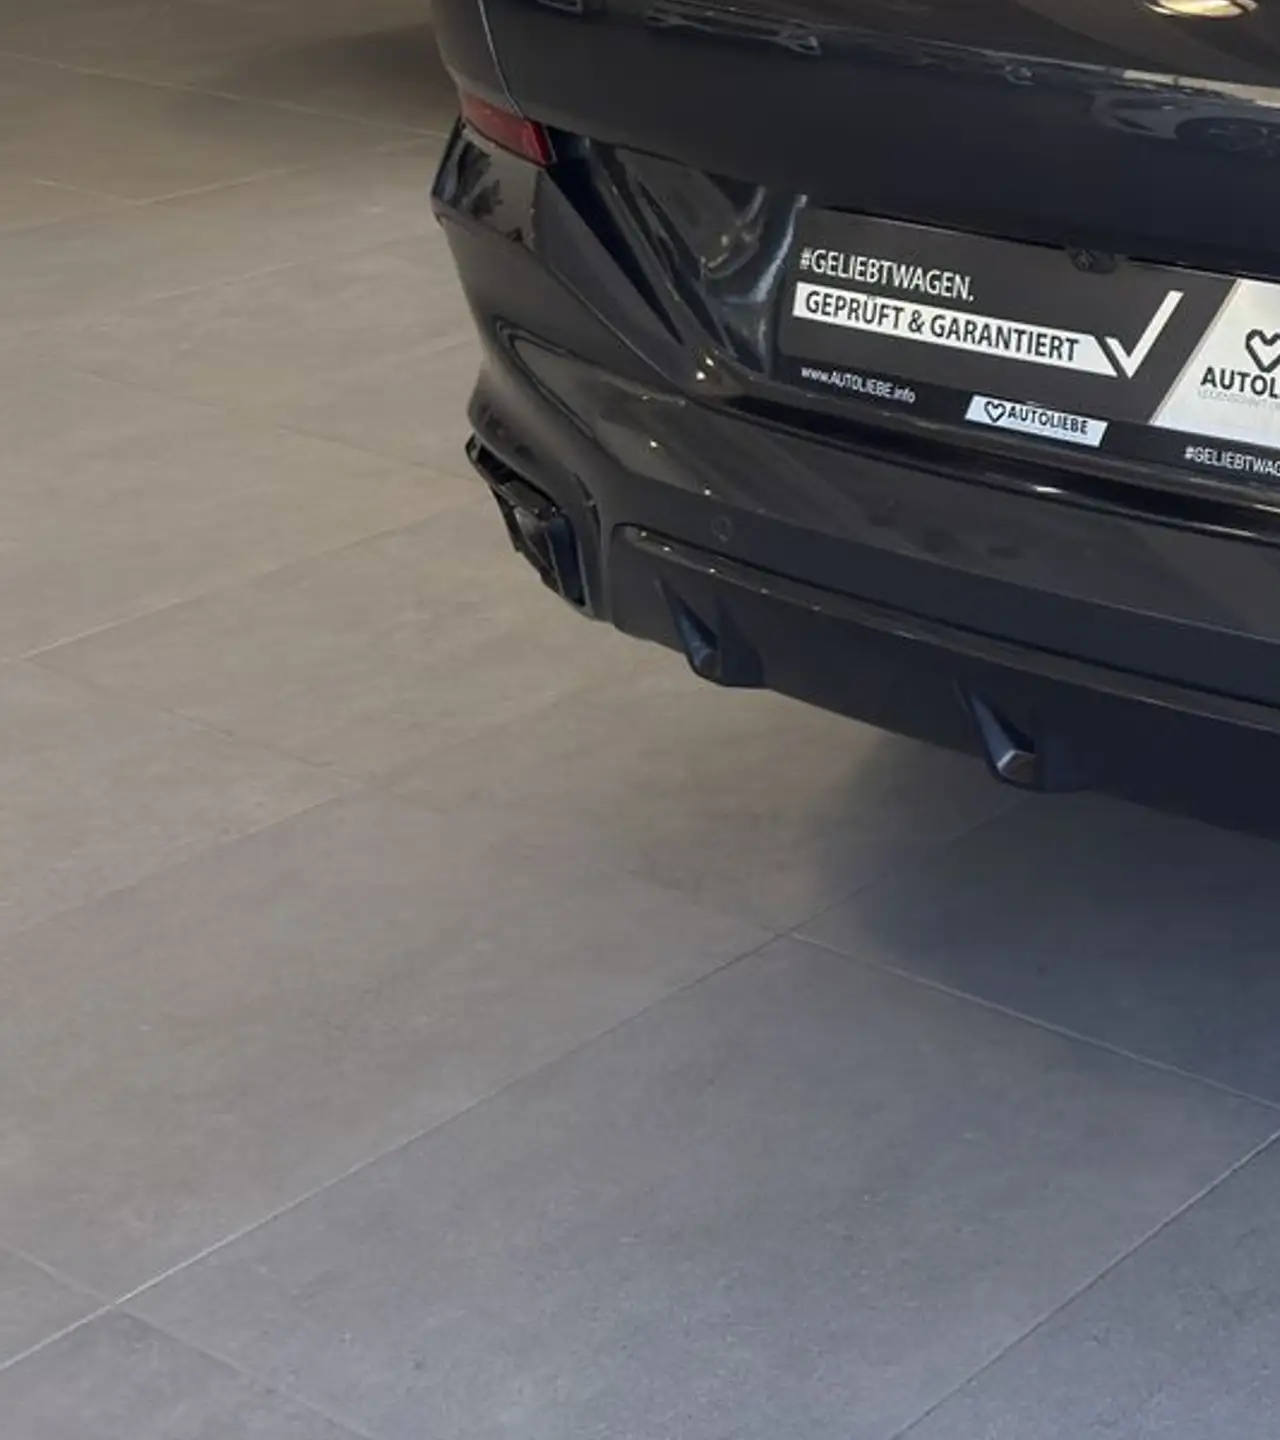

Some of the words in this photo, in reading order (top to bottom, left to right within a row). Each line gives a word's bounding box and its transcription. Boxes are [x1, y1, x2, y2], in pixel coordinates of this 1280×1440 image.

[800, 247, 974, 302] #GELIEBTWAGEN.
[805, 290, 904, 334] GEPRÜFT
[908, 310, 925, 335] &
[930, 314, 1080, 362] GARANTIERT
[800, 367, 916, 404] www.AUTOLIEBE.info
[1007, 405, 1088, 435] AUTOLIEBE
